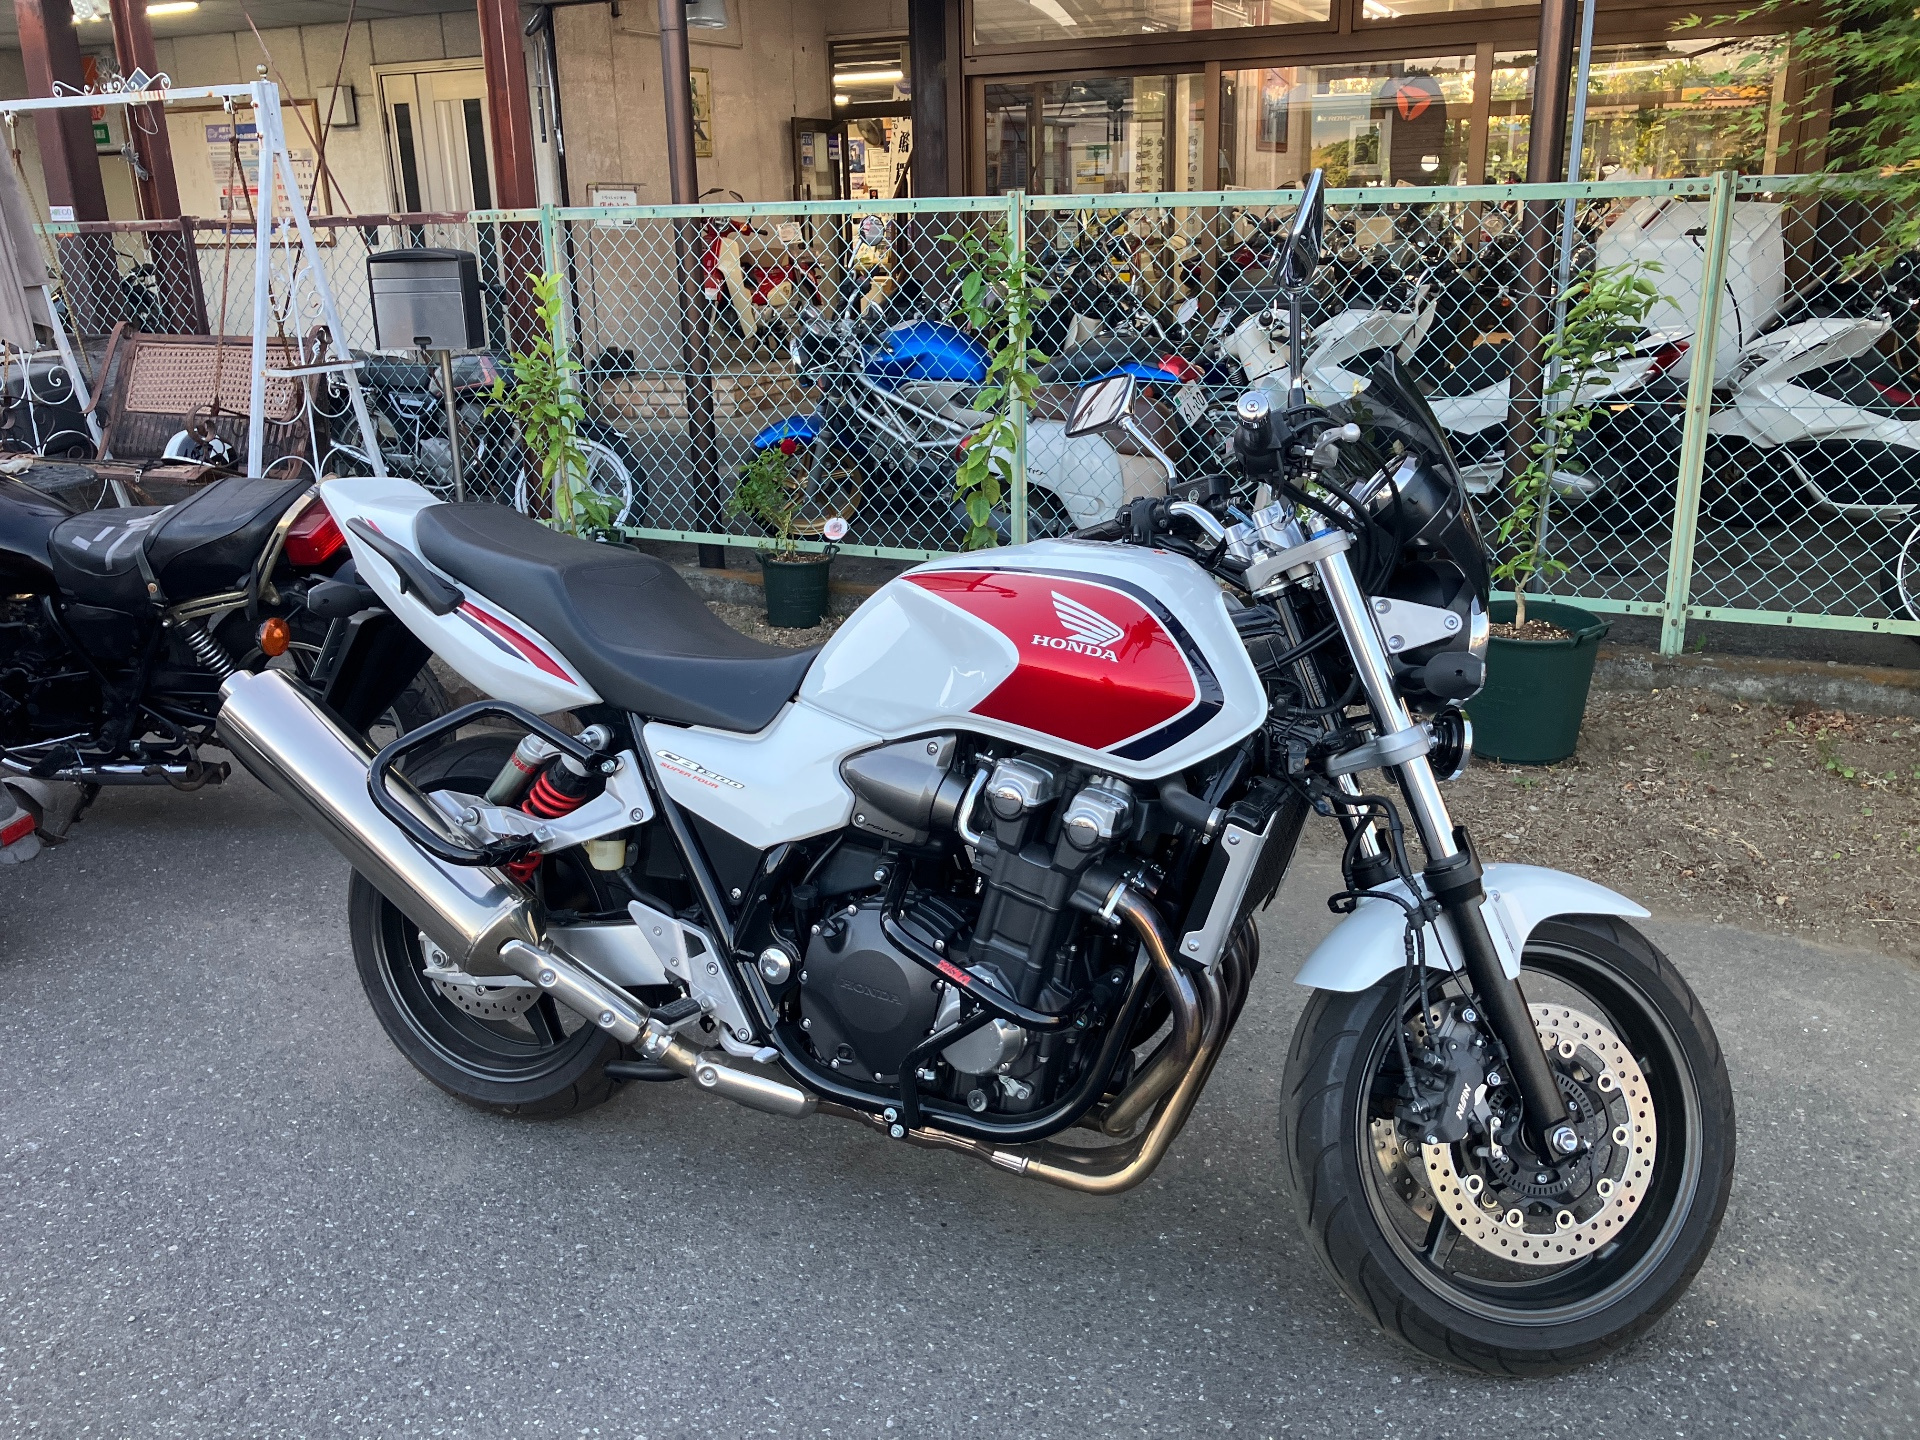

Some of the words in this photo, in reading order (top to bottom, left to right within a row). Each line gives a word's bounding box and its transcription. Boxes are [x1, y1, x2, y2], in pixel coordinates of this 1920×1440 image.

[1031, 634, 1119, 663] HONDA
[660, 761, 691, 778] SUPER
[693, 775, 720, 789] FOUR
[840, 978, 903, 1005] HONDA
